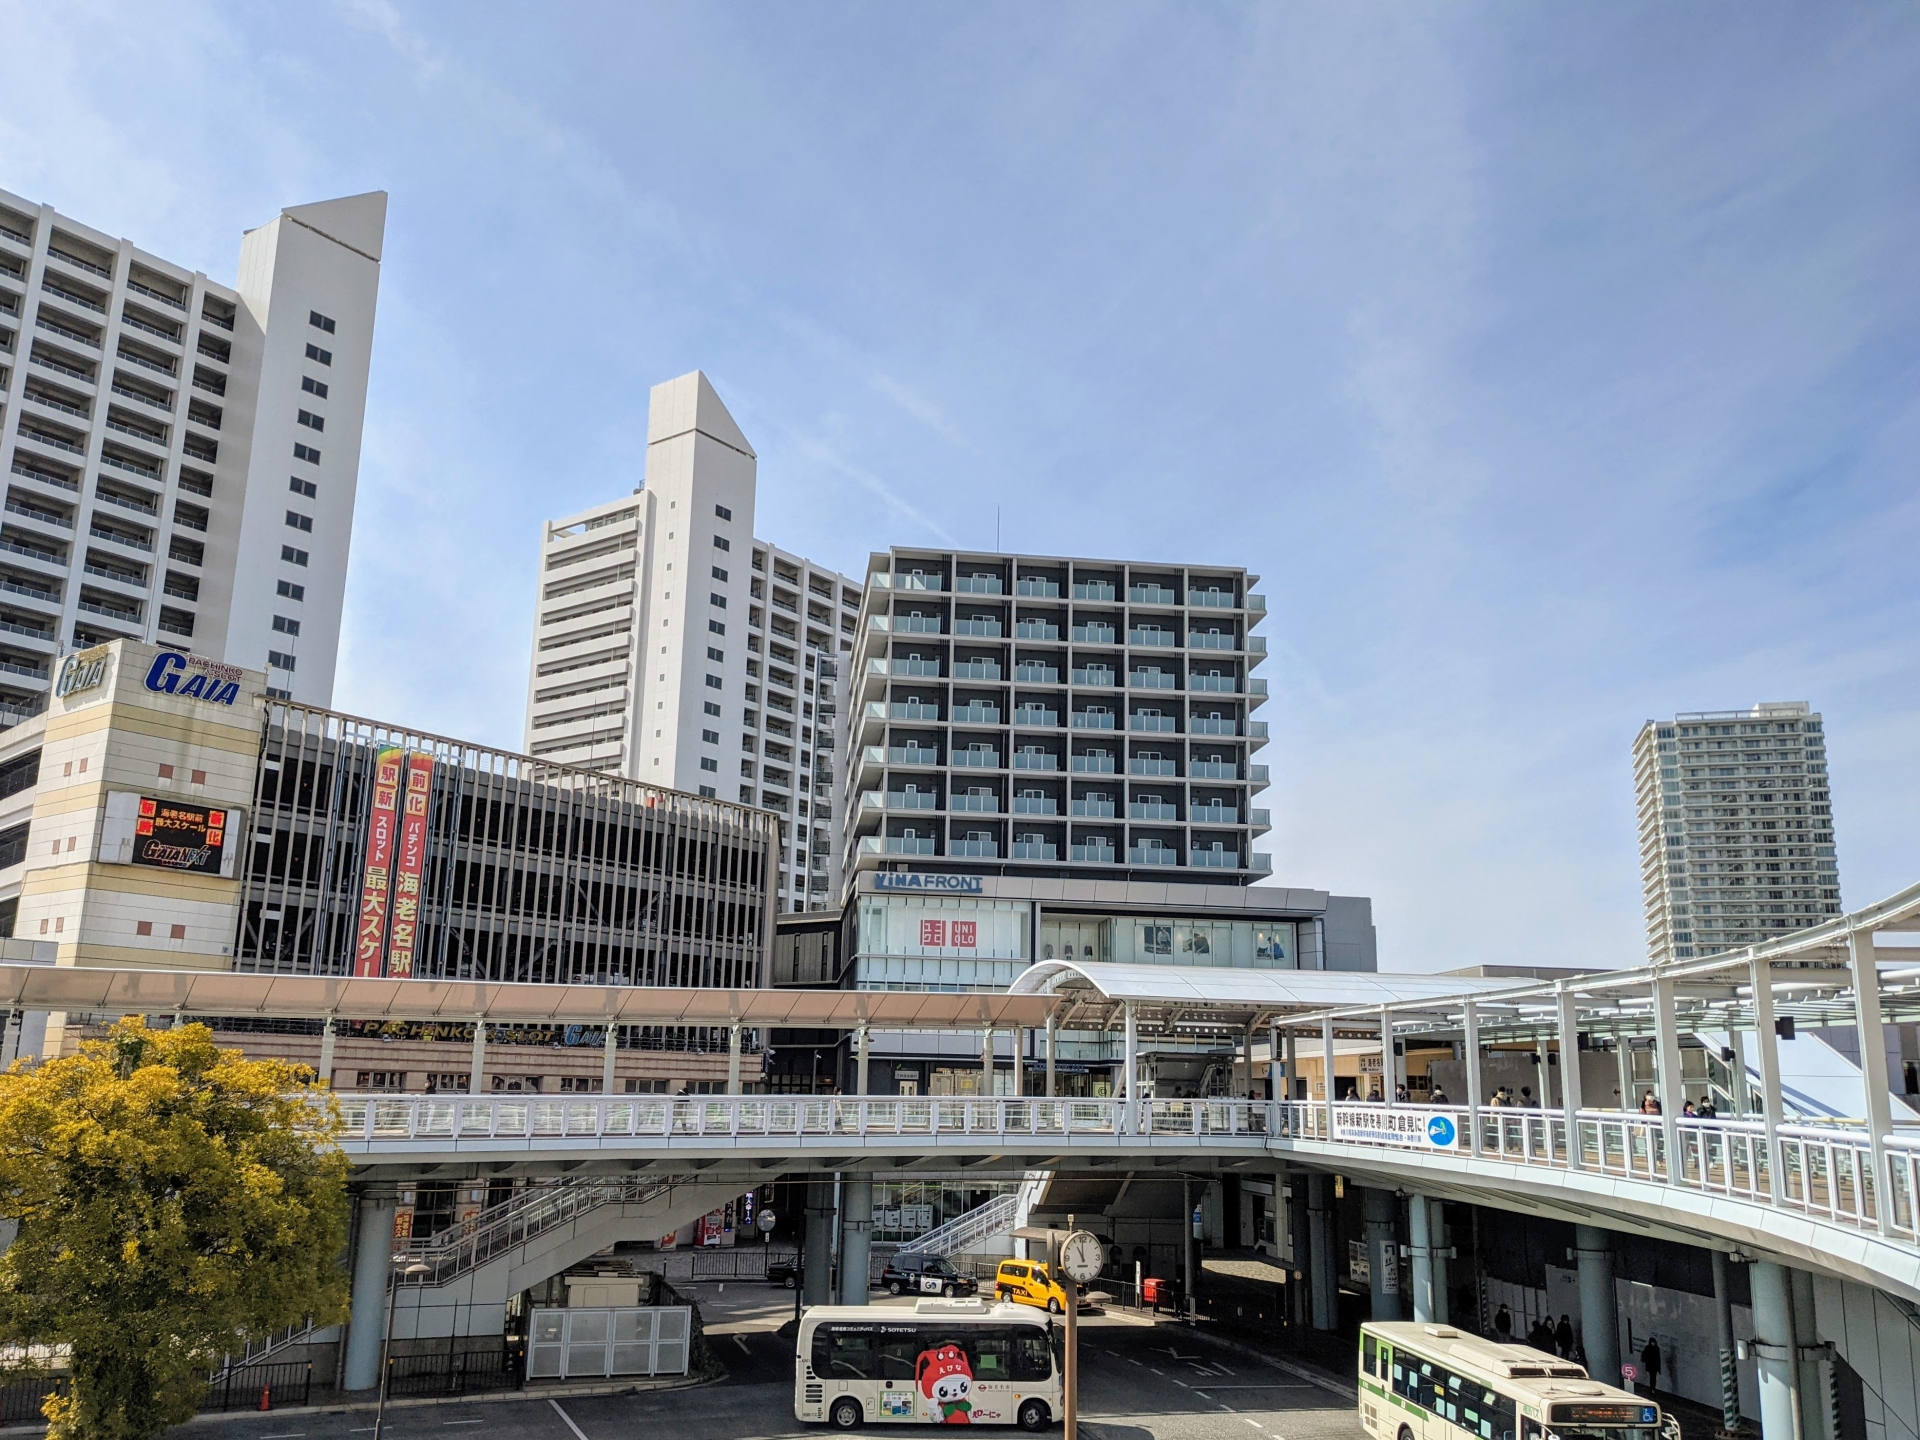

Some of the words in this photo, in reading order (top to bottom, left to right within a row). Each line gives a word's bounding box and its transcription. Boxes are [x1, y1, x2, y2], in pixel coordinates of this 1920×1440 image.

[188, 657, 243, 676] PACHINKO
[56, 655, 106, 698] GAIA
[144, 652, 241, 706] GAIA
[161, 808, 205, 824] 海老名駅前
[155, 817, 207, 833] 最大スケール
[374, 815, 388, 862] スロット
[405, 822, 421, 867] パチンコ
[389, 870, 420, 978] 海老名駅
[363, 1021, 477, 1039] PACHINKO
[506, 1029, 556, 1042] SLOT
[1079, 1236, 1087, 1244] 12
[1065, 1254, 1071, 1262] 9
[1094, 1253, 1101, 1262] 3
[1080, 1272, 1086, 1280] 6
[1012, 1287, 1028, 1297] TAXI
[939, 1364, 962, 1375] えびな
[1624, 1366, 1633, 1377] 5
